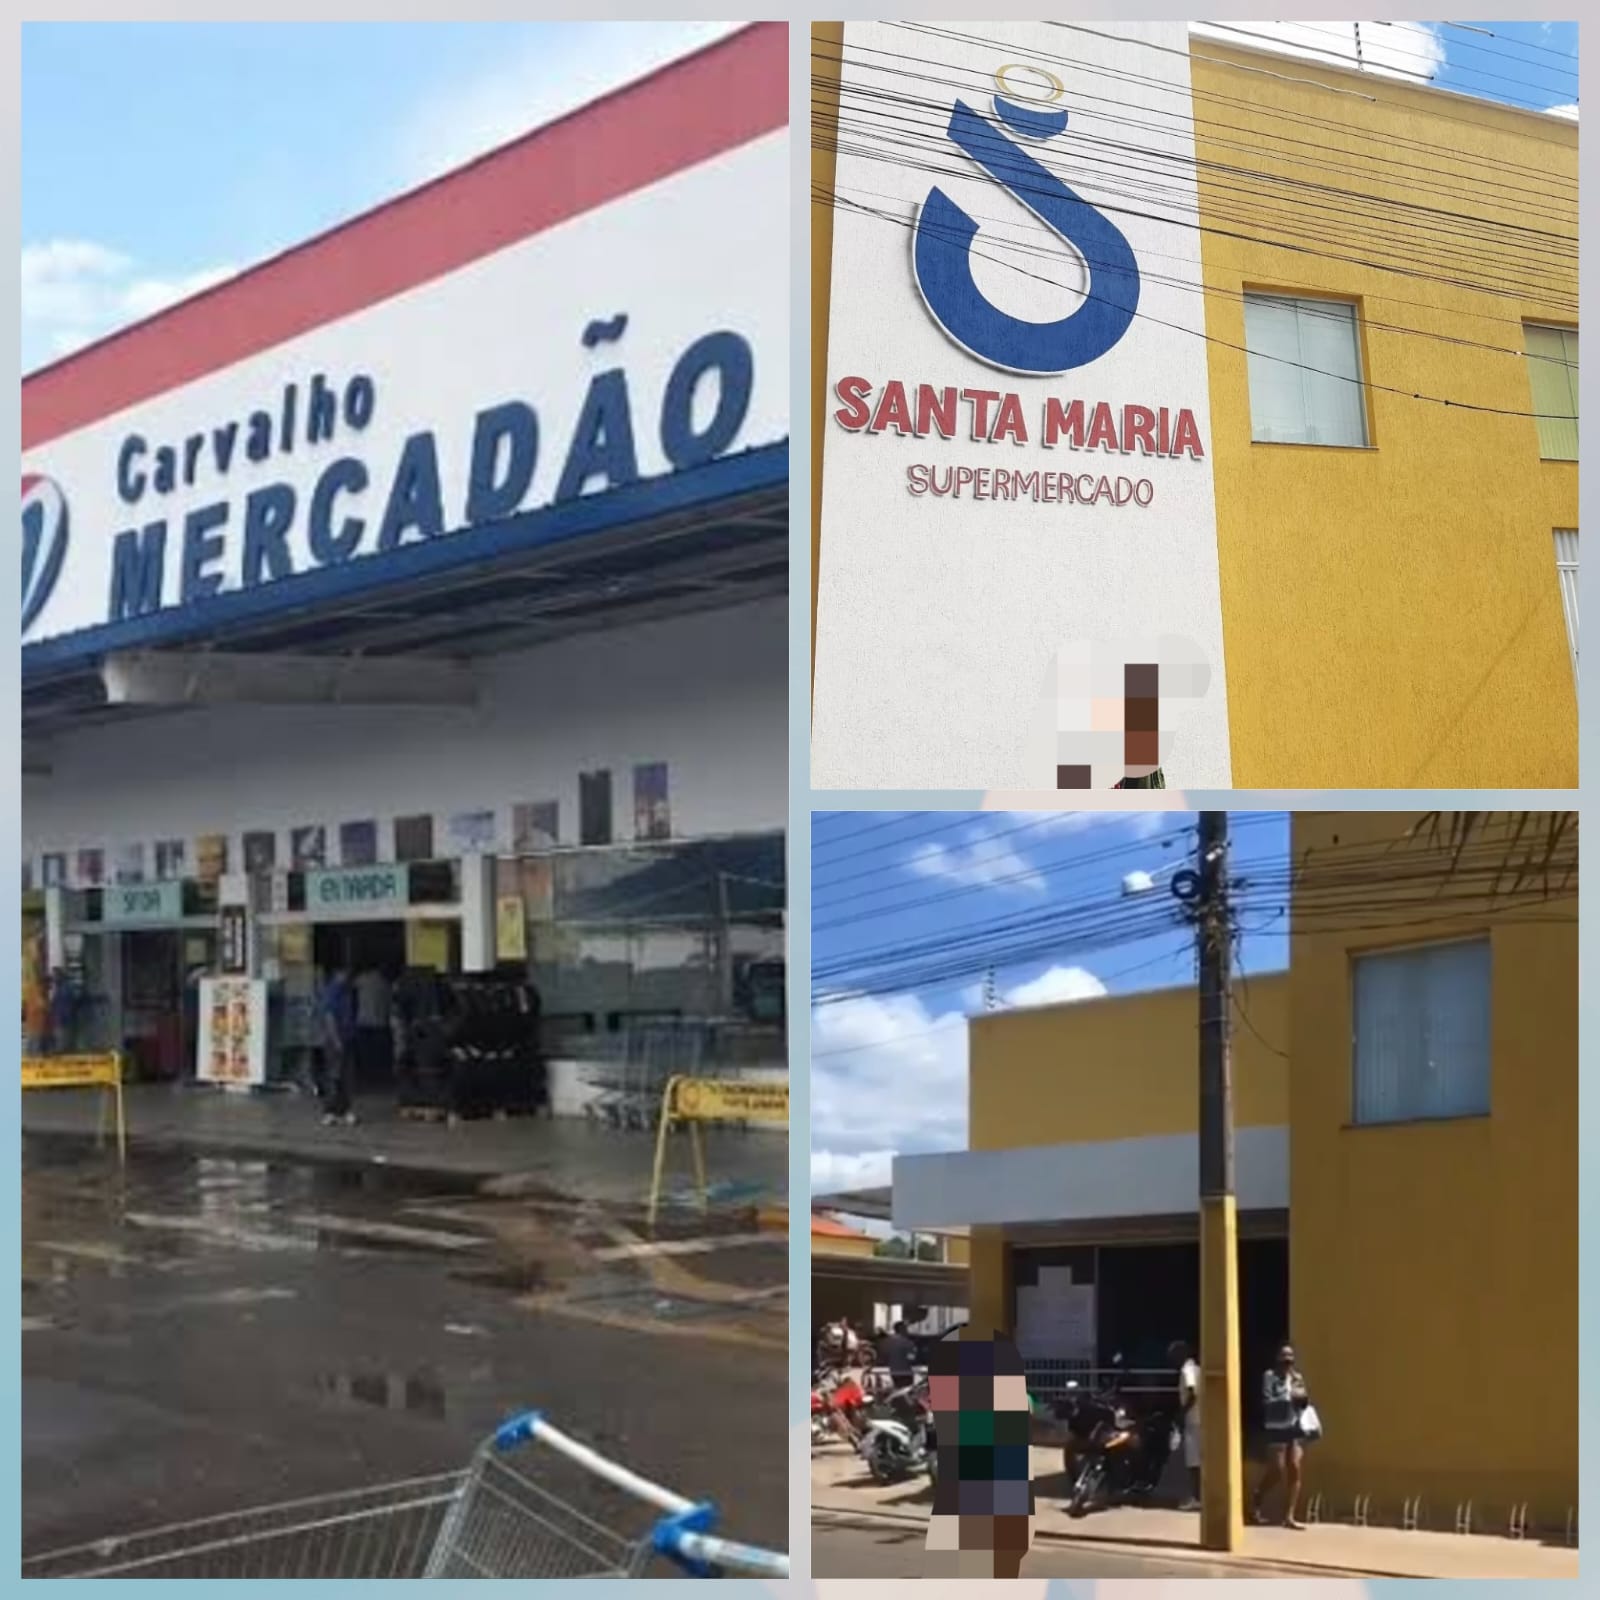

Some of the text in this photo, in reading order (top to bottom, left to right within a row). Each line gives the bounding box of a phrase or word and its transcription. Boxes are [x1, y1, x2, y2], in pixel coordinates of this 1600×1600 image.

[109, 314, 755, 620] MERCADÃO
[118, 374, 375, 503] Carvalho
[835, 376, 1206, 459] SANTA MARIA
[908, 463, 1154, 507] SUPERMERCADO
